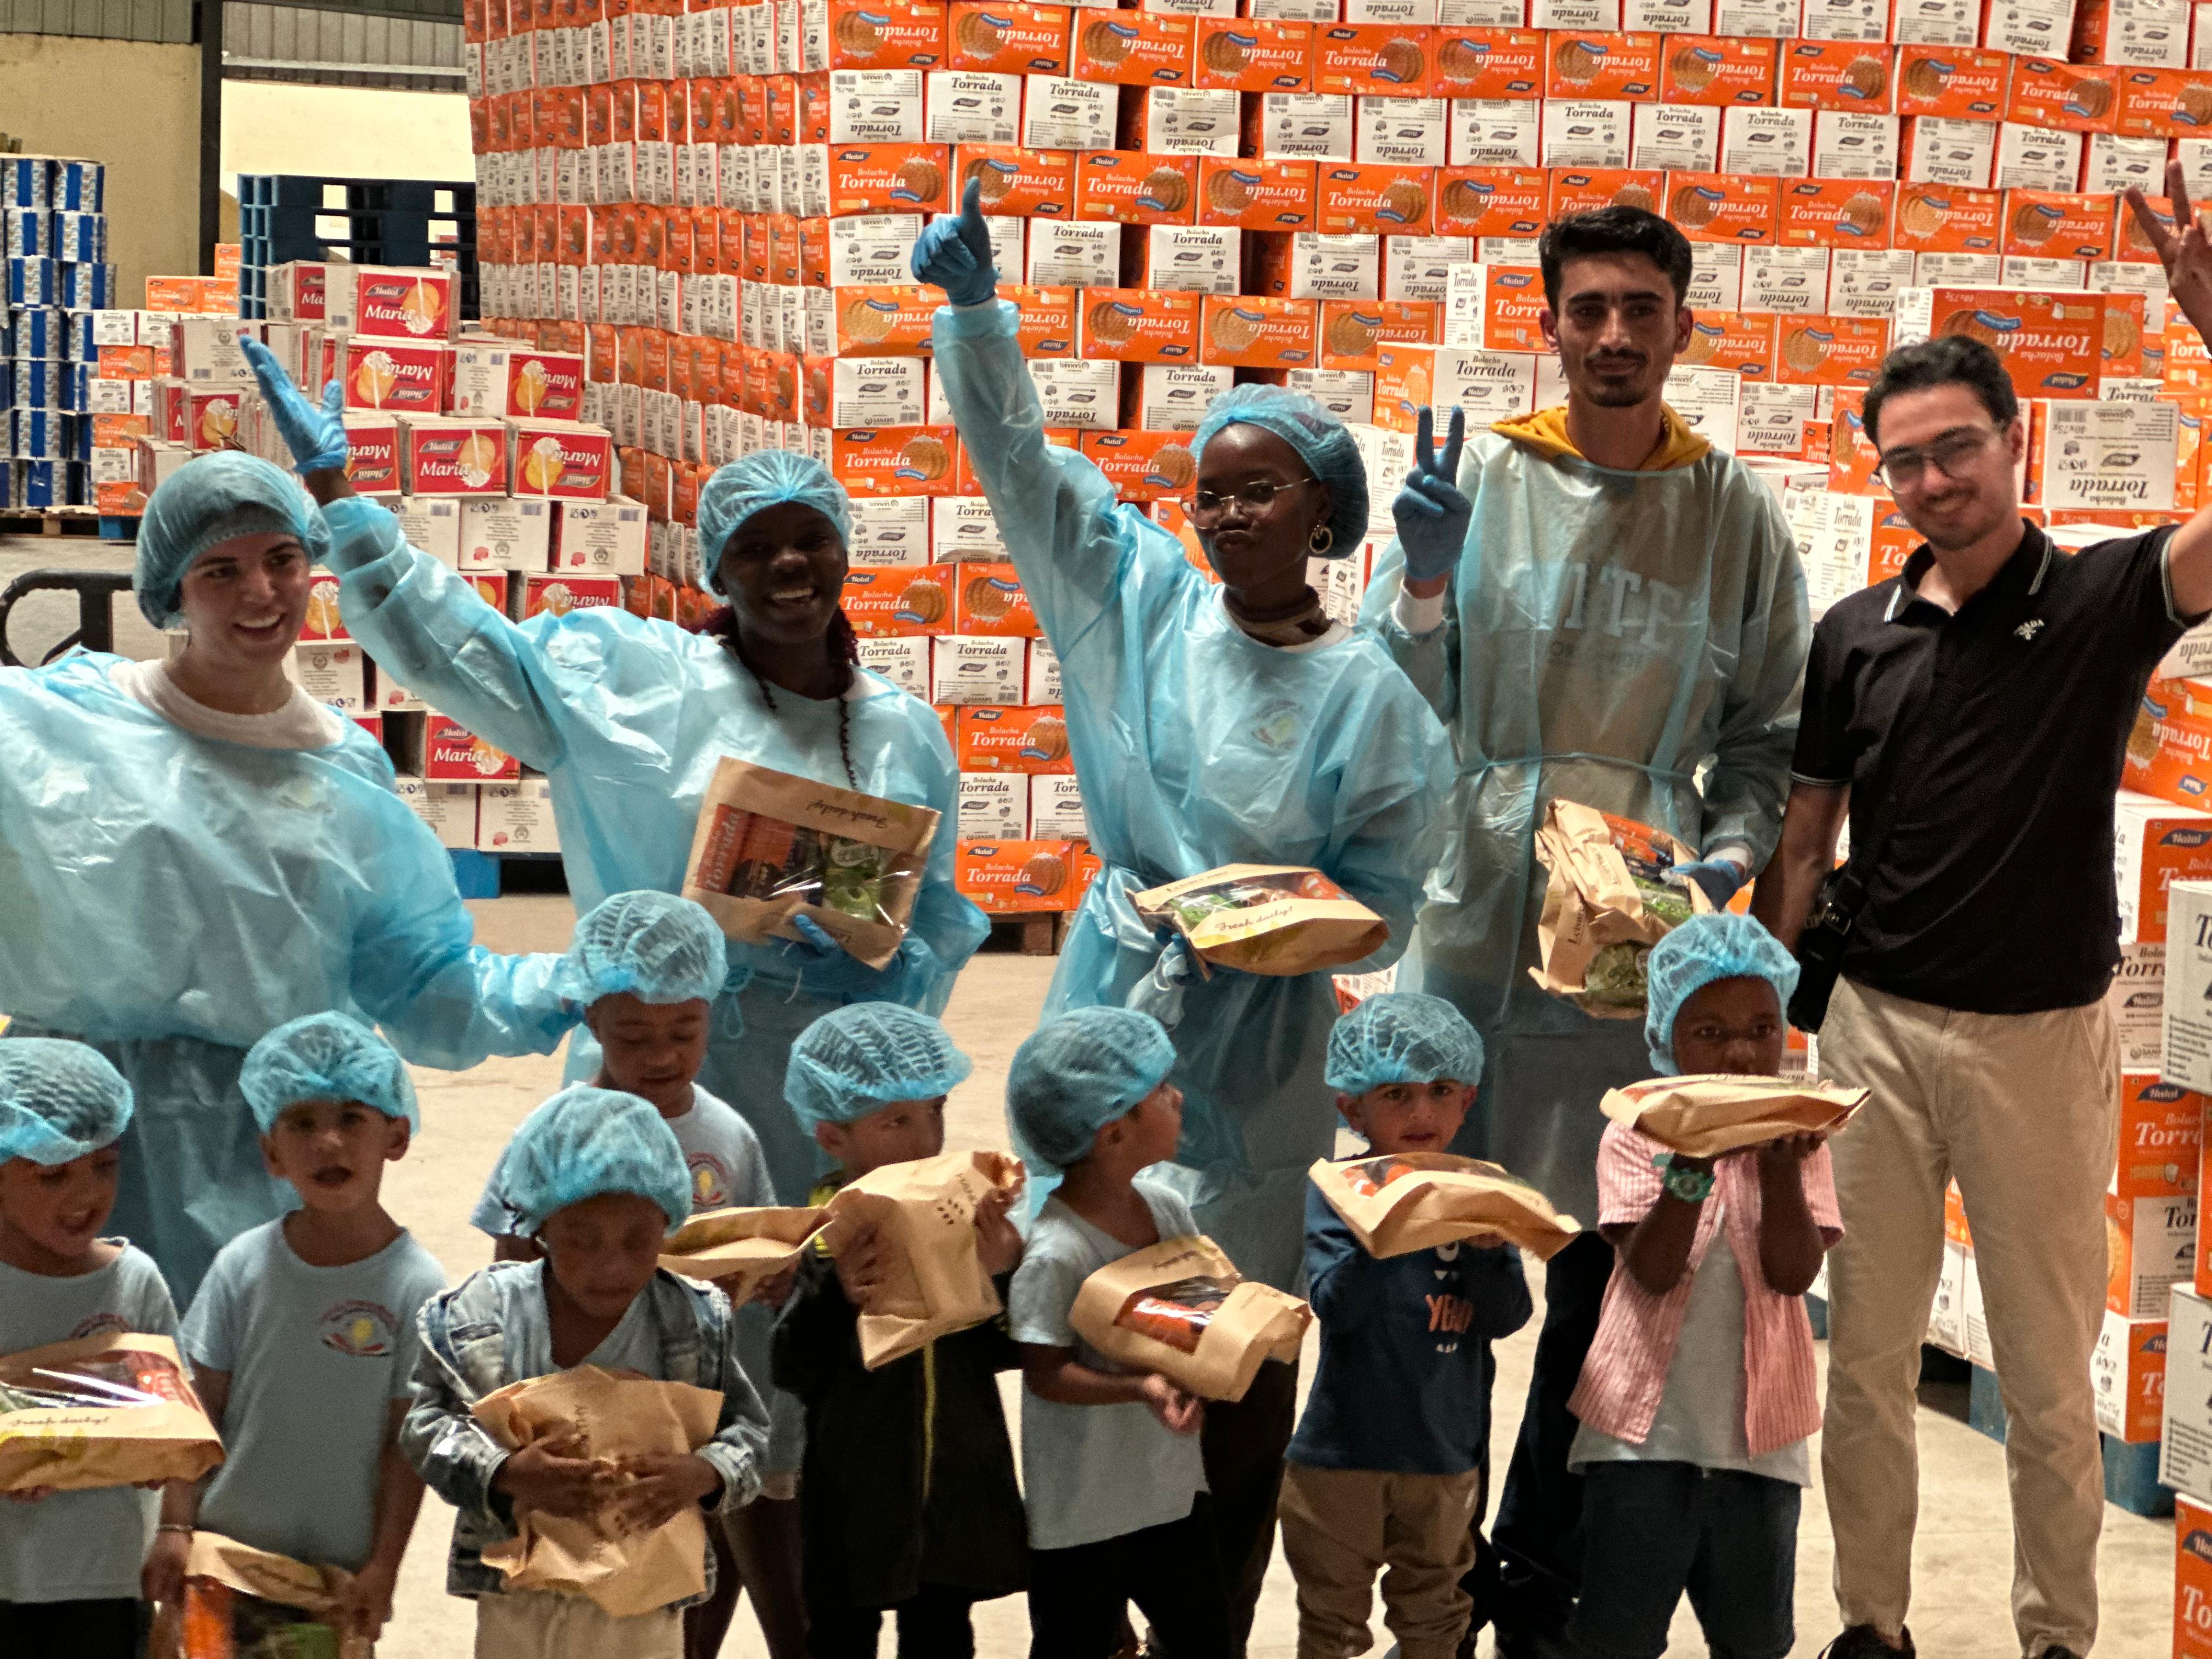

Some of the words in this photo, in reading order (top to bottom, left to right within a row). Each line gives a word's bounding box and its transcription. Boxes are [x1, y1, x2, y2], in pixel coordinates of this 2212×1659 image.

[1365, 4, 1414, 16] Torrada
[1551, 8, 1601, 21] Torrada
[1643, 14, 1690, 26] Torrada
[874, 25, 939, 41] Torrada
[996, 28, 1060, 47] Torrada
[1121, 36, 1185, 57] Torrada
[1240, 47, 1303, 65] Torrada
[1325, 50, 1388, 67] Torrada
[1475, 53, 1536, 69] Torrada
[1592, 56, 1652, 72] Torrada
[1707, 63, 1767, 80] Torrada
[1792, 67, 1854, 83] Torrada
[951, 78, 1002, 91] Torrada
[1939, 74, 1999, 91] Torrada
[1050, 83, 1100, 98] Torrada
[2021, 81, 2079, 100] Torrada
[2128, 95, 2186, 110] Torrada
[1565, 107, 1613, 119] Torrada
[1656, 111, 1703, 123] Torrada
[1747, 114, 1795, 127] Torrada
[1838, 117, 1883, 129] Torrada
[851, 124, 902, 135] Torrada
[1165, 137, 1215, 150] Torrada
[1281, 143, 1330, 155] Torrada
[1376, 146, 1426, 157] Torrada
[1470, 148, 1519, 159] Torrada
[839, 174, 906, 188] Torrada
[1003, 174, 1065, 191] Torrada
[1087, 178, 1152, 195] Torrada
[1245, 185, 1308, 202] Torrada
[1328, 192, 1393, 208] Torrada
[1479, 195, 1541, 210] Torrada
[1708, 201, 1768, 218] Torrada
[1790, 205, 1850, 221] Torrada
[1934, 210, 1994, 228] Torrada
[1053, 225, 1104, 239] Torrada
[2047, 218, 2106, 235] Torrada
[1173, 232, 1223, 245] Torrada
[851, 269, 902, 279] Torrada
[1454, 272, 1477, 287] Torrada
[1311, 280, 1360, 291] Torrada
[1759, 295, 1810, 307] Torrada
[365, 304, 415, 322] Maria
[1127, 317, 1190, 333] Torrada
[1248, 323, 1309, 338] Torrada
[1708, 338, 1767, 353] Torrada
[1819, 343, 1878, 358] Torrada
[1996, 334, 2091, 356] Torrada
[856, 364, 907, 375] Torrada
[1456, 360, 1516, 377] Torrada
[1045, 411, 1096, 422] Torrada
[1382, 444, 1404, 458] Torrada
[844, 453, 911, 467] Torrada
[1097, 459, 1160, 473] Torrada
[421, 461, 469, 477] Maria
[2070, 481, 2148, 500] Torrada
[956, 505, 991, 517] Torra
[856, 549, 907, 560] Torrada
[844, 596, 910, 610] Torrada
[860, 645, 910, 656] Torrada
[957, 643, 1008, 655] Torrada
[971, 732, 1036, 746] Torrada
[434, 747, 482, 763] Maria
[960, 781, 1009, 792] Torrada
[1054, 782, 1080, 792] Torr
[967, 868, 1030, 882] Torrada
[1216, 919, 1254, 930] Fresh
[2135, 1123, 2203, 1146] Torra
